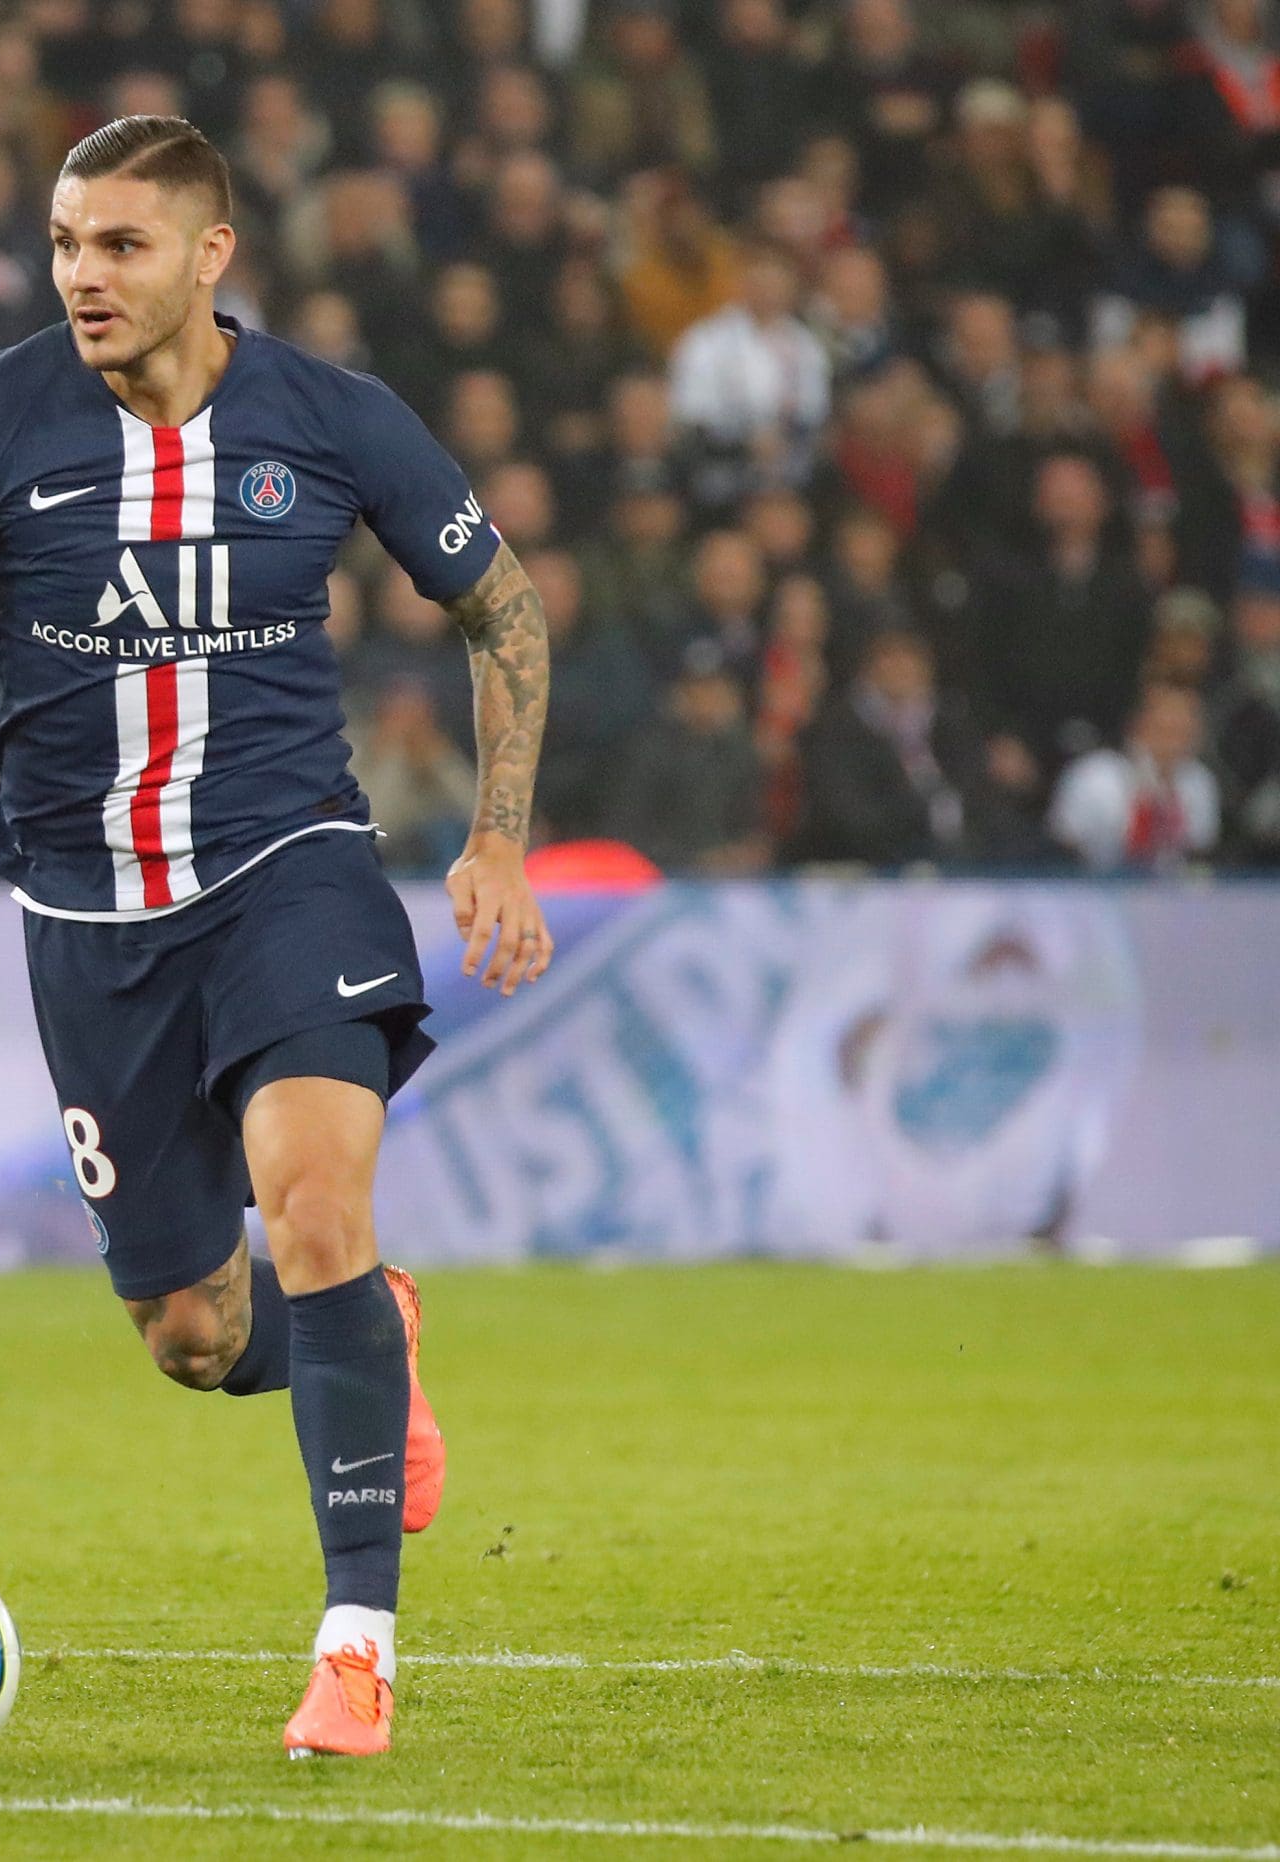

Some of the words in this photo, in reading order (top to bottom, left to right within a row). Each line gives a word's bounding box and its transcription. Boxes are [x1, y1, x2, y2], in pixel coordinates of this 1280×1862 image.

[250, 463, 288, 479] PARIS
[31, 620, 112, 656] ACCOR
[119, 636, 178, 657] LIVE
[183, 620, 297, 655] LIMITLESS
[63, 1107, 118, 1199] 8
[328, 1488, 397, 1508] PARIS
